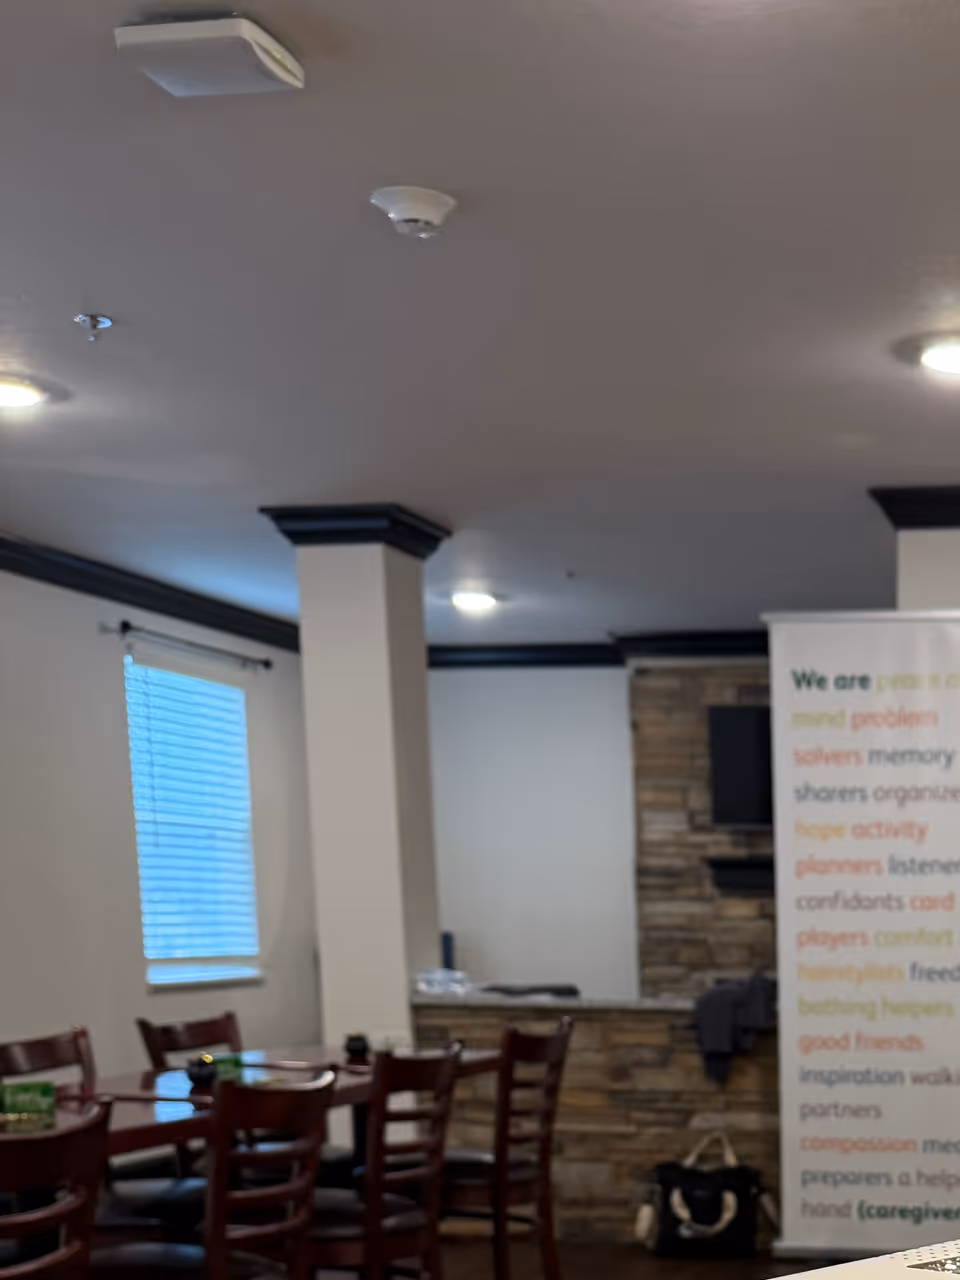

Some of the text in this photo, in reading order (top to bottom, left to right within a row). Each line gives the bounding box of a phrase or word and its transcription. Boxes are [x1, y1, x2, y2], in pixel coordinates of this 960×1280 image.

[791, 669, 828, 691] We
[834, 673, 871, 690] are
[792, 707, 939, 731] mind problem
[793, 747, 957, 769] solvers memory
[794, 783, 867, 801] sharers
[795, 820, 930, 842] hope activity
[795, 855, 884, 878] planners
[796, 892, 956, 911] confidants card
[796, 928, 955, 949] players comfort
[798, 997, 956, 1021] bathing helpers
[798, 1032, 924, 1054] good friends
[799, 1066, 905, 1088] inspiration
[800, 1102, 882, 1121] partners
[800, 1135, 917, 1154] compassion
[801, 1168, 893, 1187] preparers
[897, 1172, 911, 1186] a
[801, 1200, 850, 1218] hand
